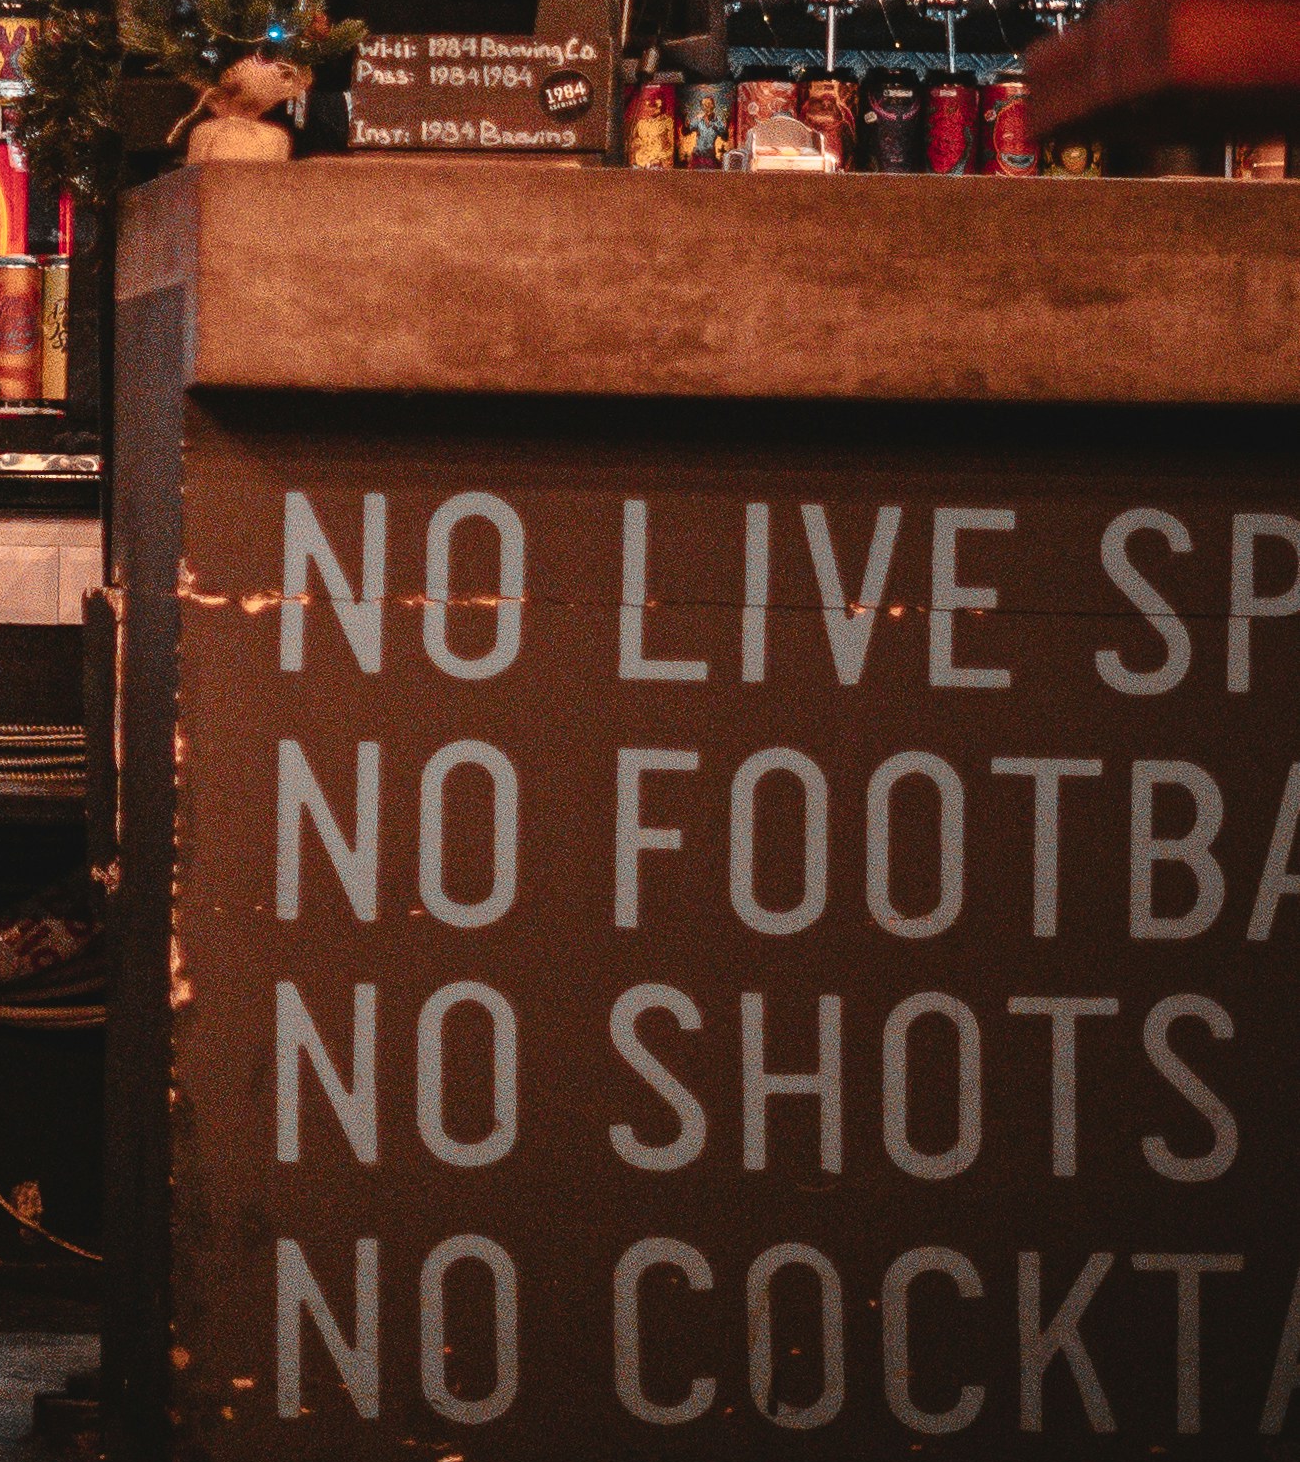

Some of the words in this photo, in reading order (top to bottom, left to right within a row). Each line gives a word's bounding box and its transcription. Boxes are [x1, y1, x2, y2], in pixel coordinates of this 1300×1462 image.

[427, 37, 478, 59] 1984
[429, 64, 534, 88] 19841984
[544, 80, 587, 105] 1984
[278, 490, 527, 681] NO
[616, 498, 1017, 690] LIVE
[275, 738, 519, 931] NO
[275, 979, 519, 1168] NO
[607, 982, 1239, 1183] SHOTS
[275, 1233, 519, 1426] NO
